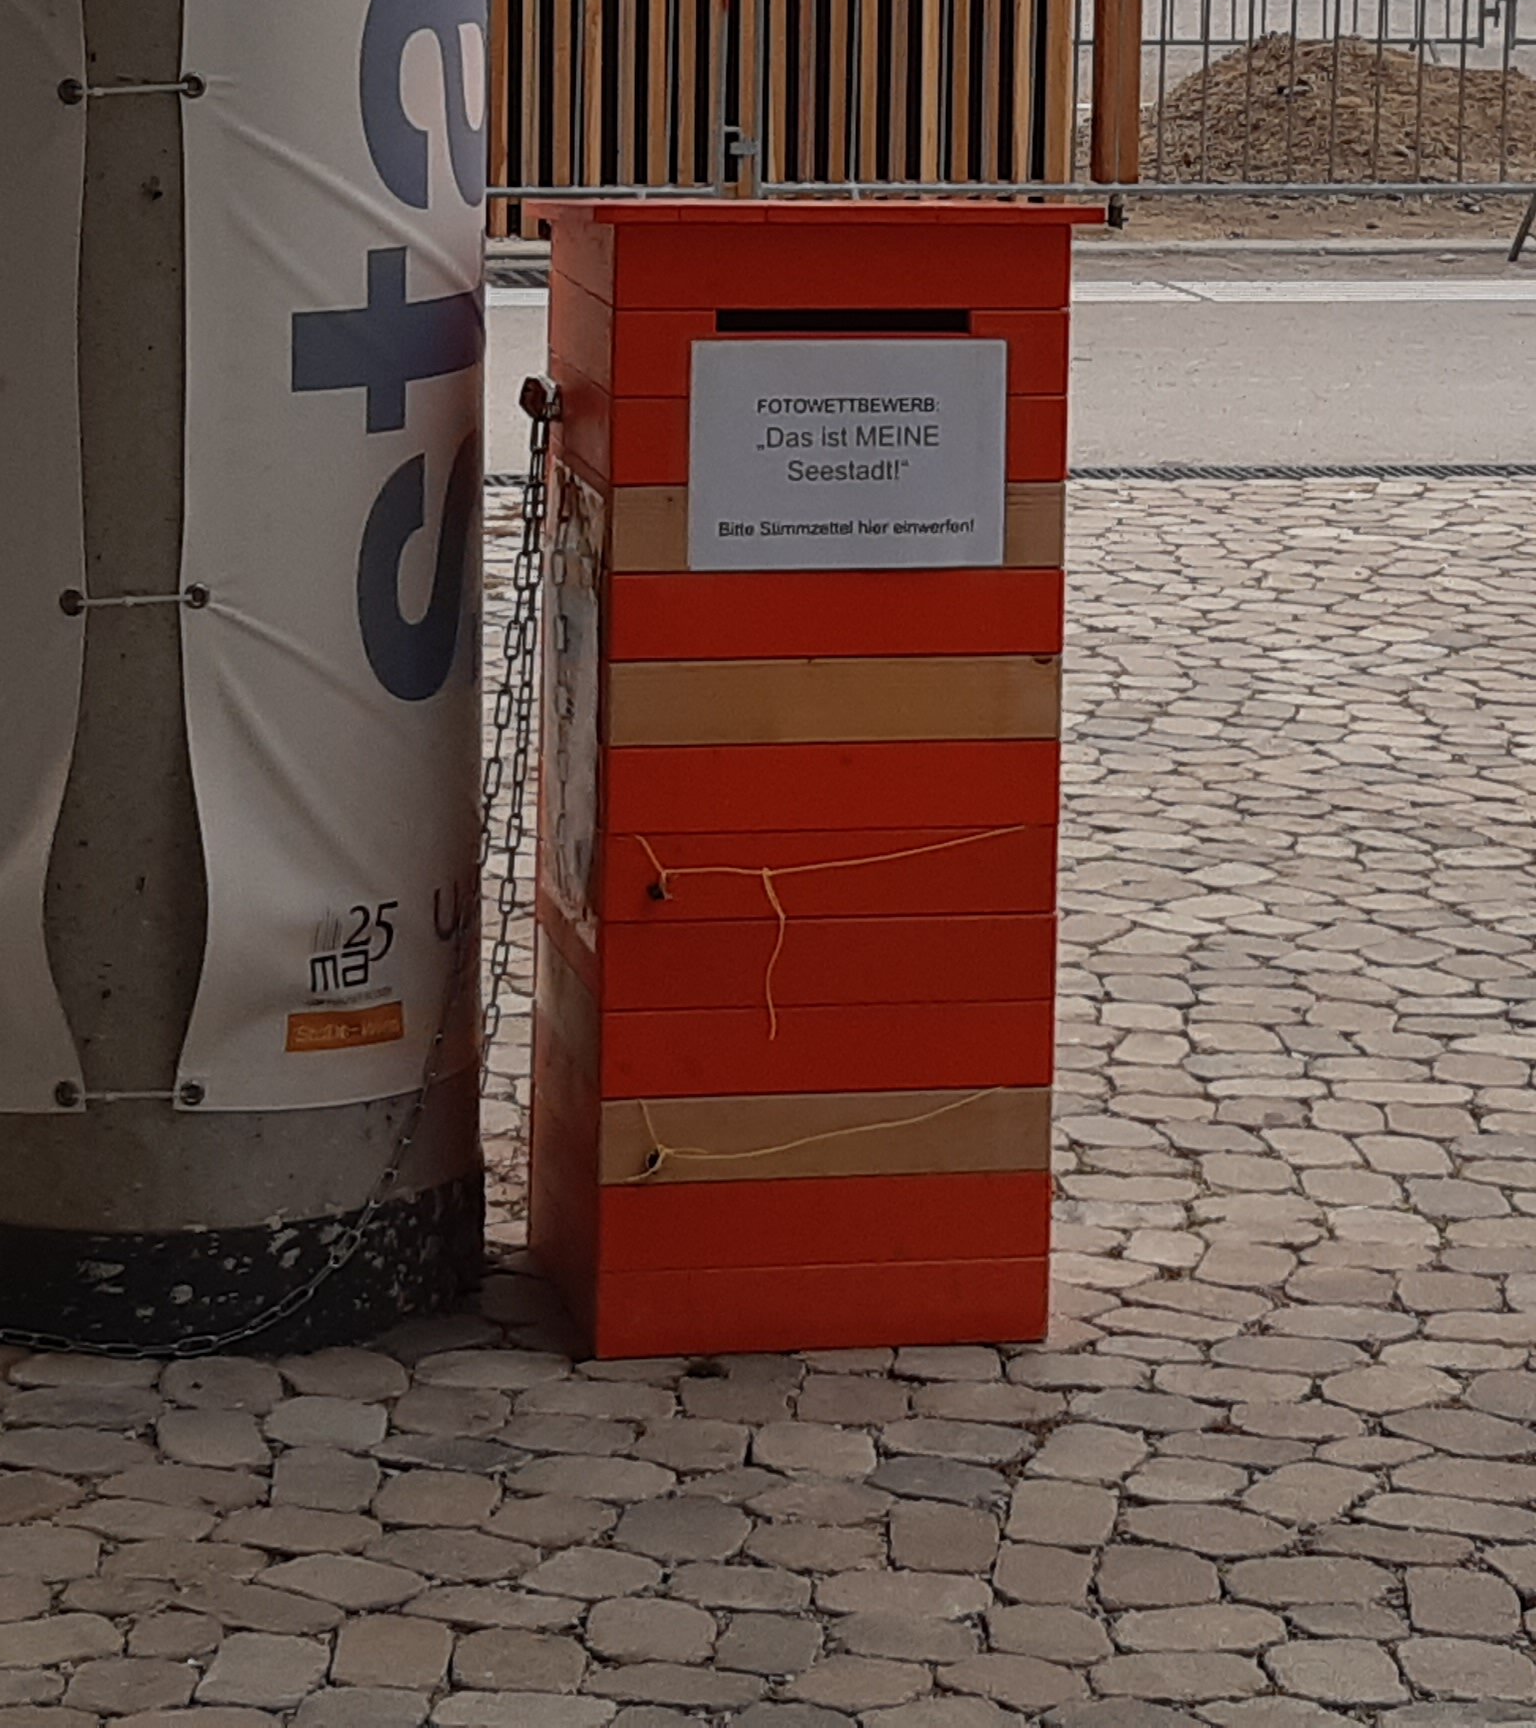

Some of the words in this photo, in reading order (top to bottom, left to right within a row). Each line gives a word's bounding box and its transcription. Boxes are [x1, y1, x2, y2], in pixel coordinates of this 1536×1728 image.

[756, 397, 940, 414] FOTOWETTBEWERB:
[821, 425, 848, 448] ist
[855, 425, 940, 447] MEINE
[718, 520, 755, 537] Bitte
[760, 519, 854, 536] Stimmzettel
[858, 518, 890, 535] hier
[893, 518, 975, 535] einwerfen!
